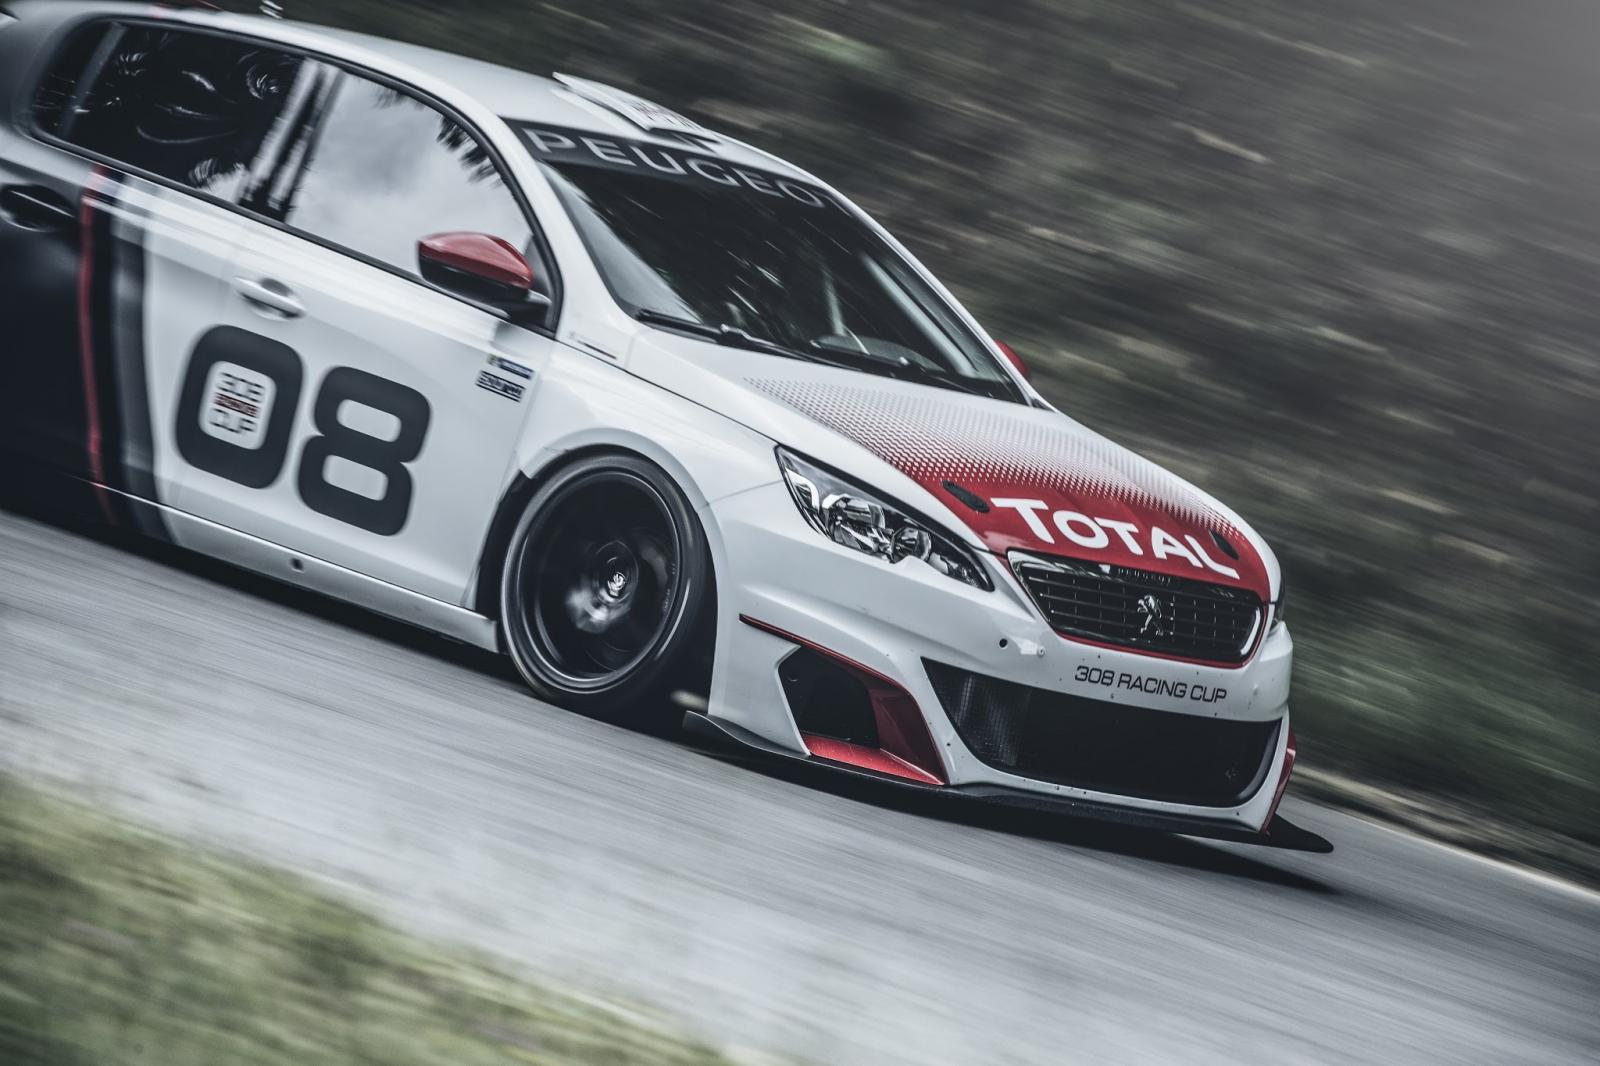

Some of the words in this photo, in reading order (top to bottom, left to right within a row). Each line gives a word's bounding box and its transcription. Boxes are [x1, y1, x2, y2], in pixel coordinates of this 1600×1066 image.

[174, 324, 431, 537] 08
[990, 497, 1240, 580] TOTAL
[1075, 665, 1115, 686] 308
[1117, 673, 1188, 698] RACING
[1190, 684, 1227, 703] CUP
